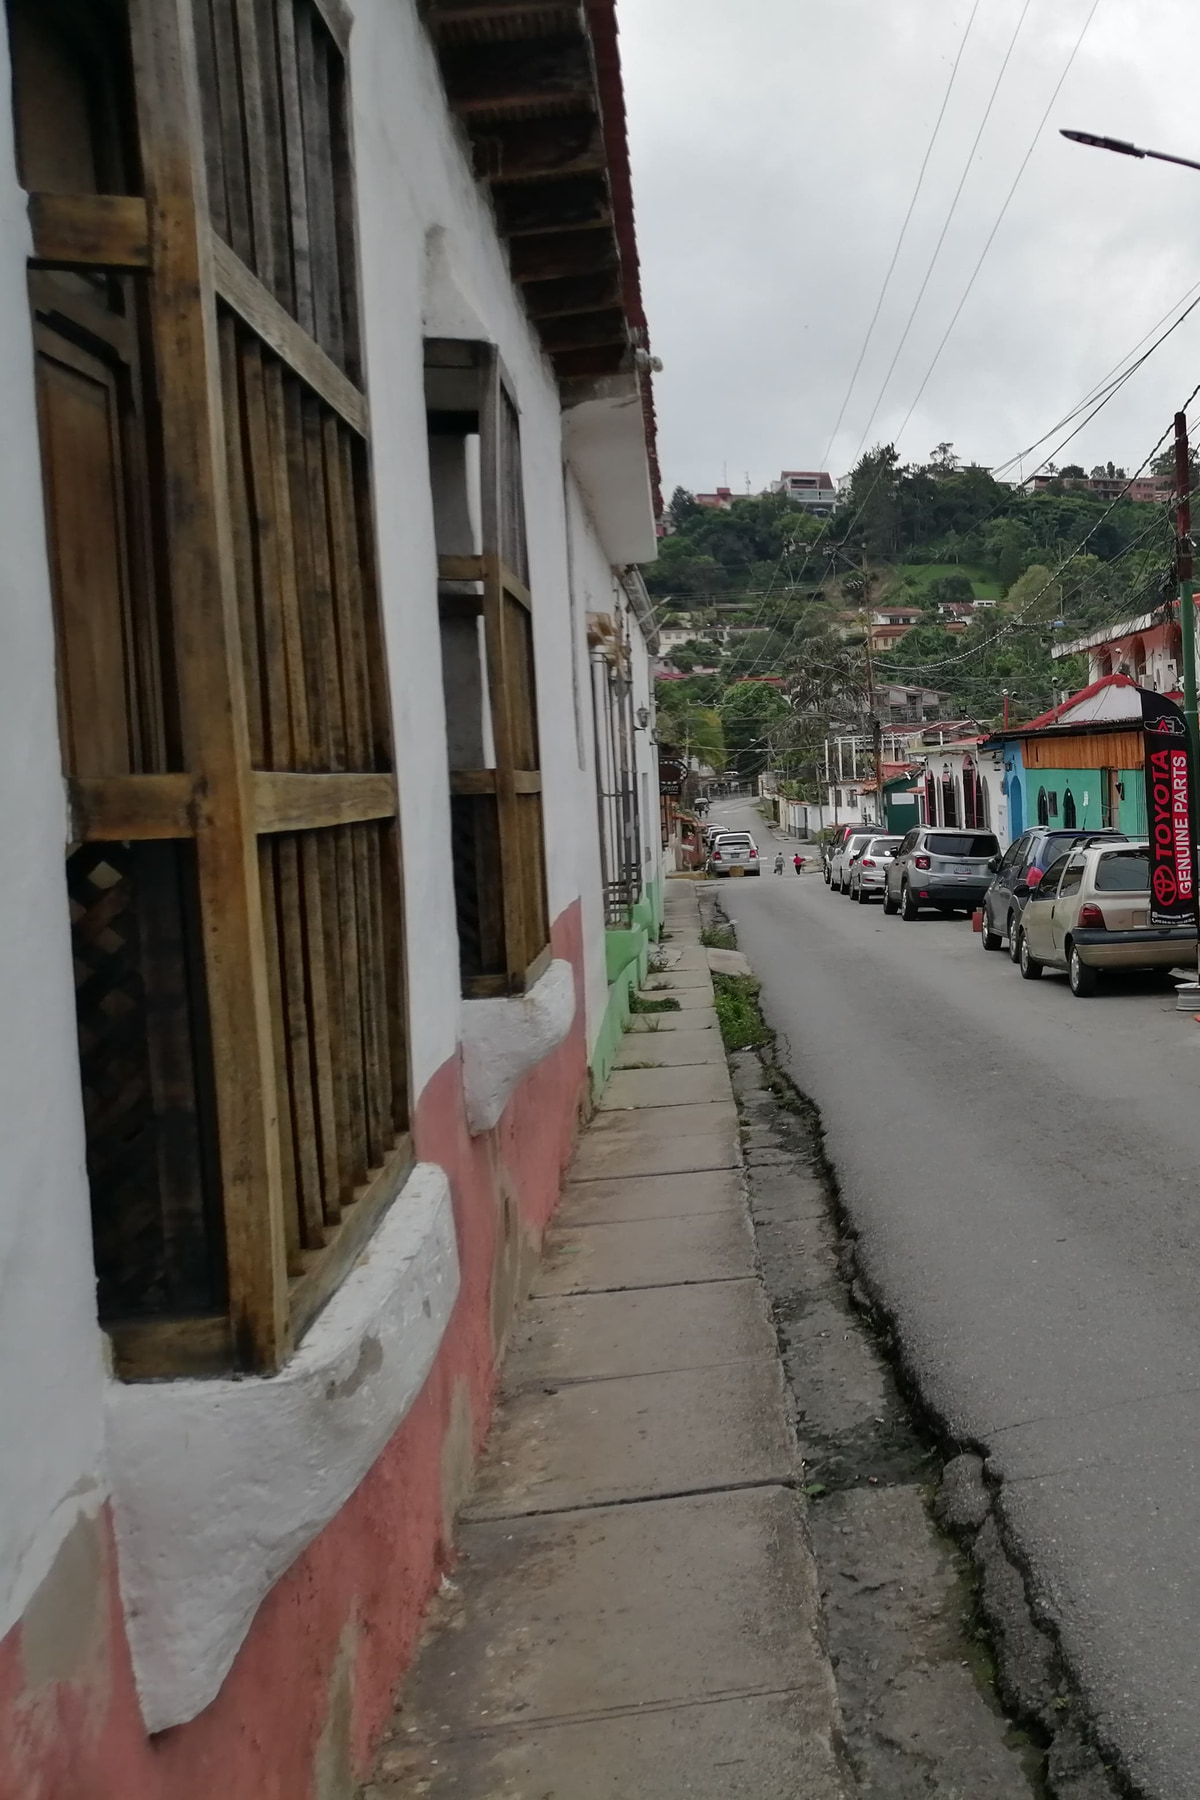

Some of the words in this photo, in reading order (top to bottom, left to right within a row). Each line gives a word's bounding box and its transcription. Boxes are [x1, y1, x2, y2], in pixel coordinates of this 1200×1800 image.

[1151, 750, 1173, 860] TOYOTA
[1172, 755, 1188, 813] PARTS
[1174, 818, 1192, 895] GENUINE
